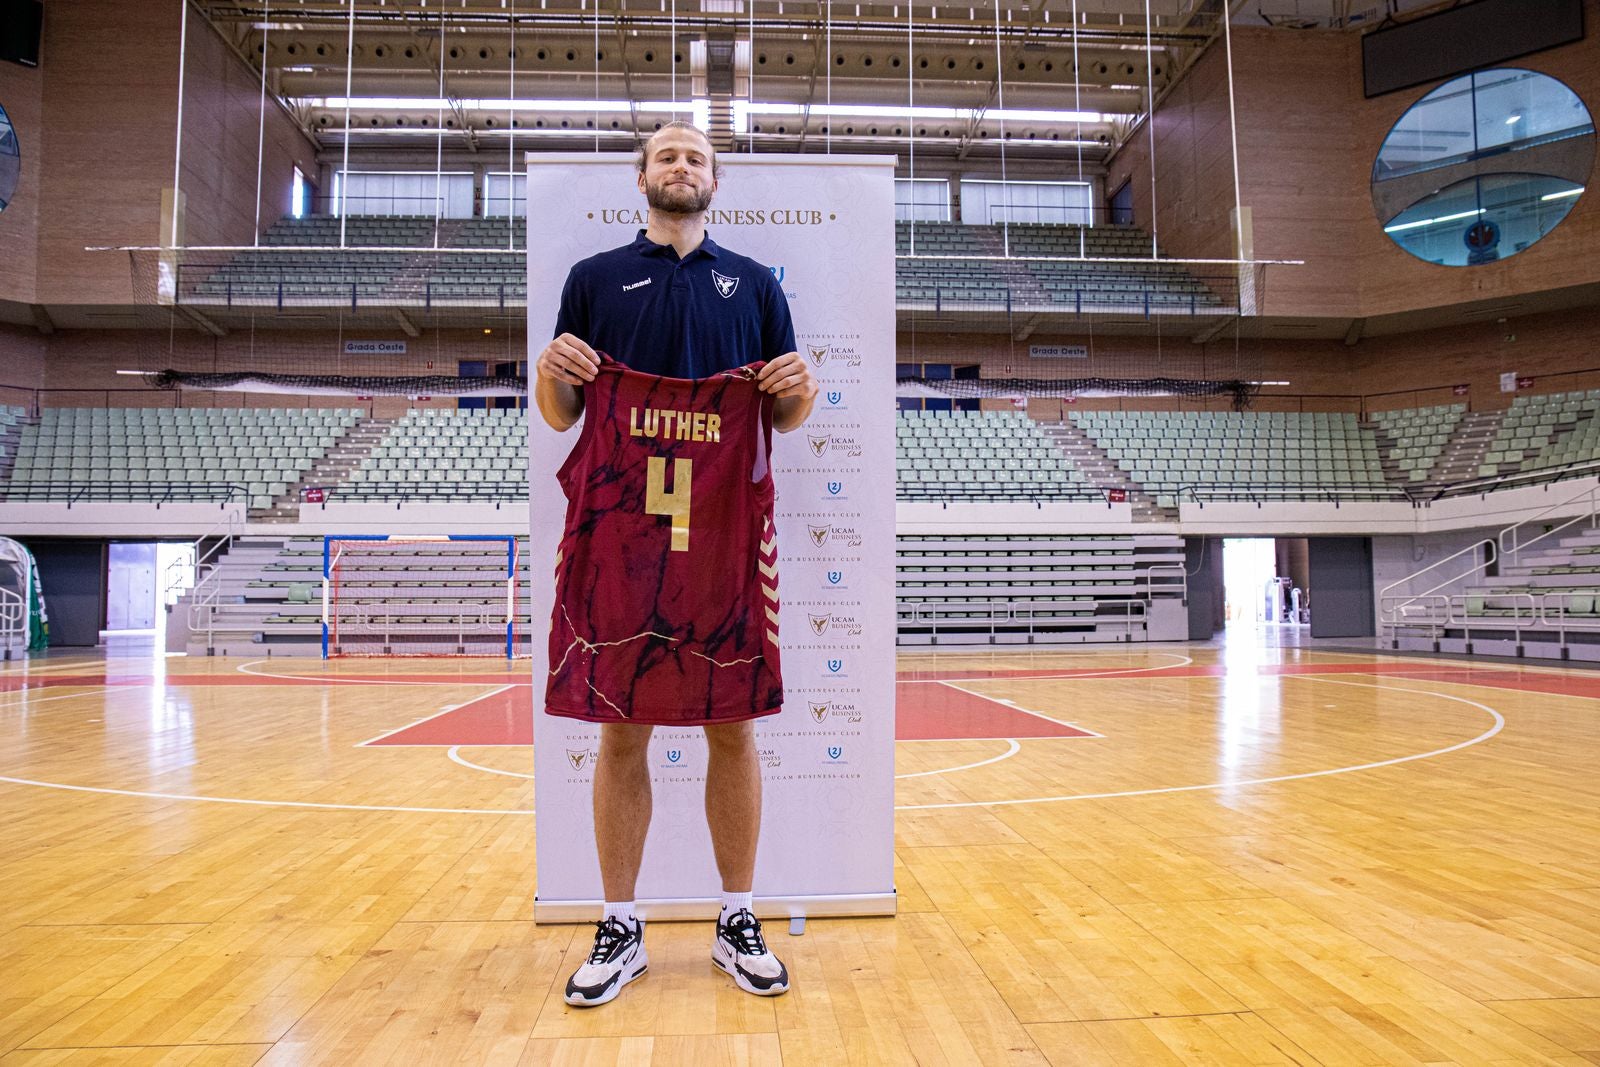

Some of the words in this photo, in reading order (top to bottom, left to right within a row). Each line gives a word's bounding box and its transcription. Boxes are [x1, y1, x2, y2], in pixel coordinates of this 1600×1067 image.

[704, 210, 765, 225] SINESS
[770, 210, 822, 225] CLUB
[622, 277, 652, 291] hummel
[347, 343, 375, 351] Grada
[378, 343, 404, 351] Oeste
[1031, 347, 1058, 355] Grada
[1062, 347, 1085, 355] Oeste
[630, 407, 721, 443] LUTHER
[645, 456, 693, 552] 4
